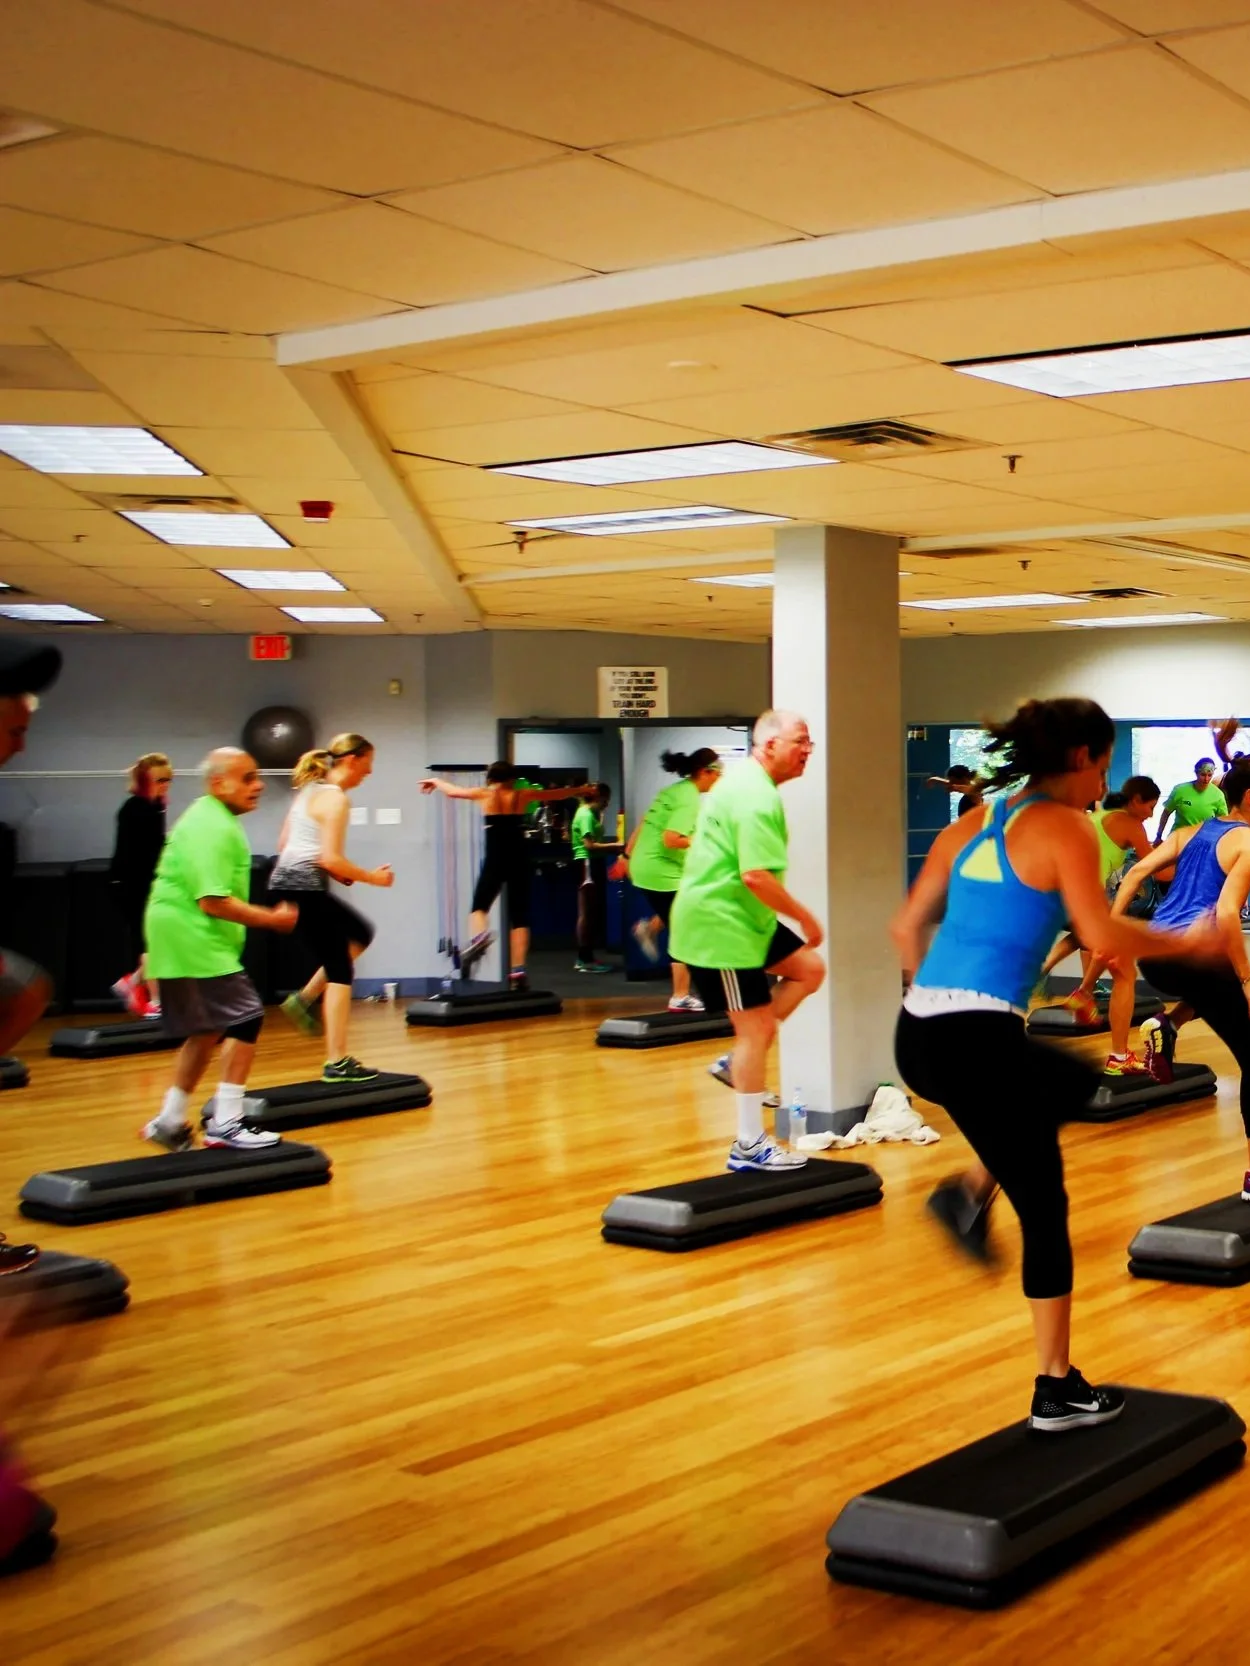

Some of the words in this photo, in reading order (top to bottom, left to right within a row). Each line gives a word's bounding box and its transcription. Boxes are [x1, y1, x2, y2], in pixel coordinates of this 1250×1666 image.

[255, 636, 286, 659] EXIT
[612, 700, 634, 708] TRAIN
[635, 700, 657, 708] HARD
[619, 709, 650, 718] ENOUGH
